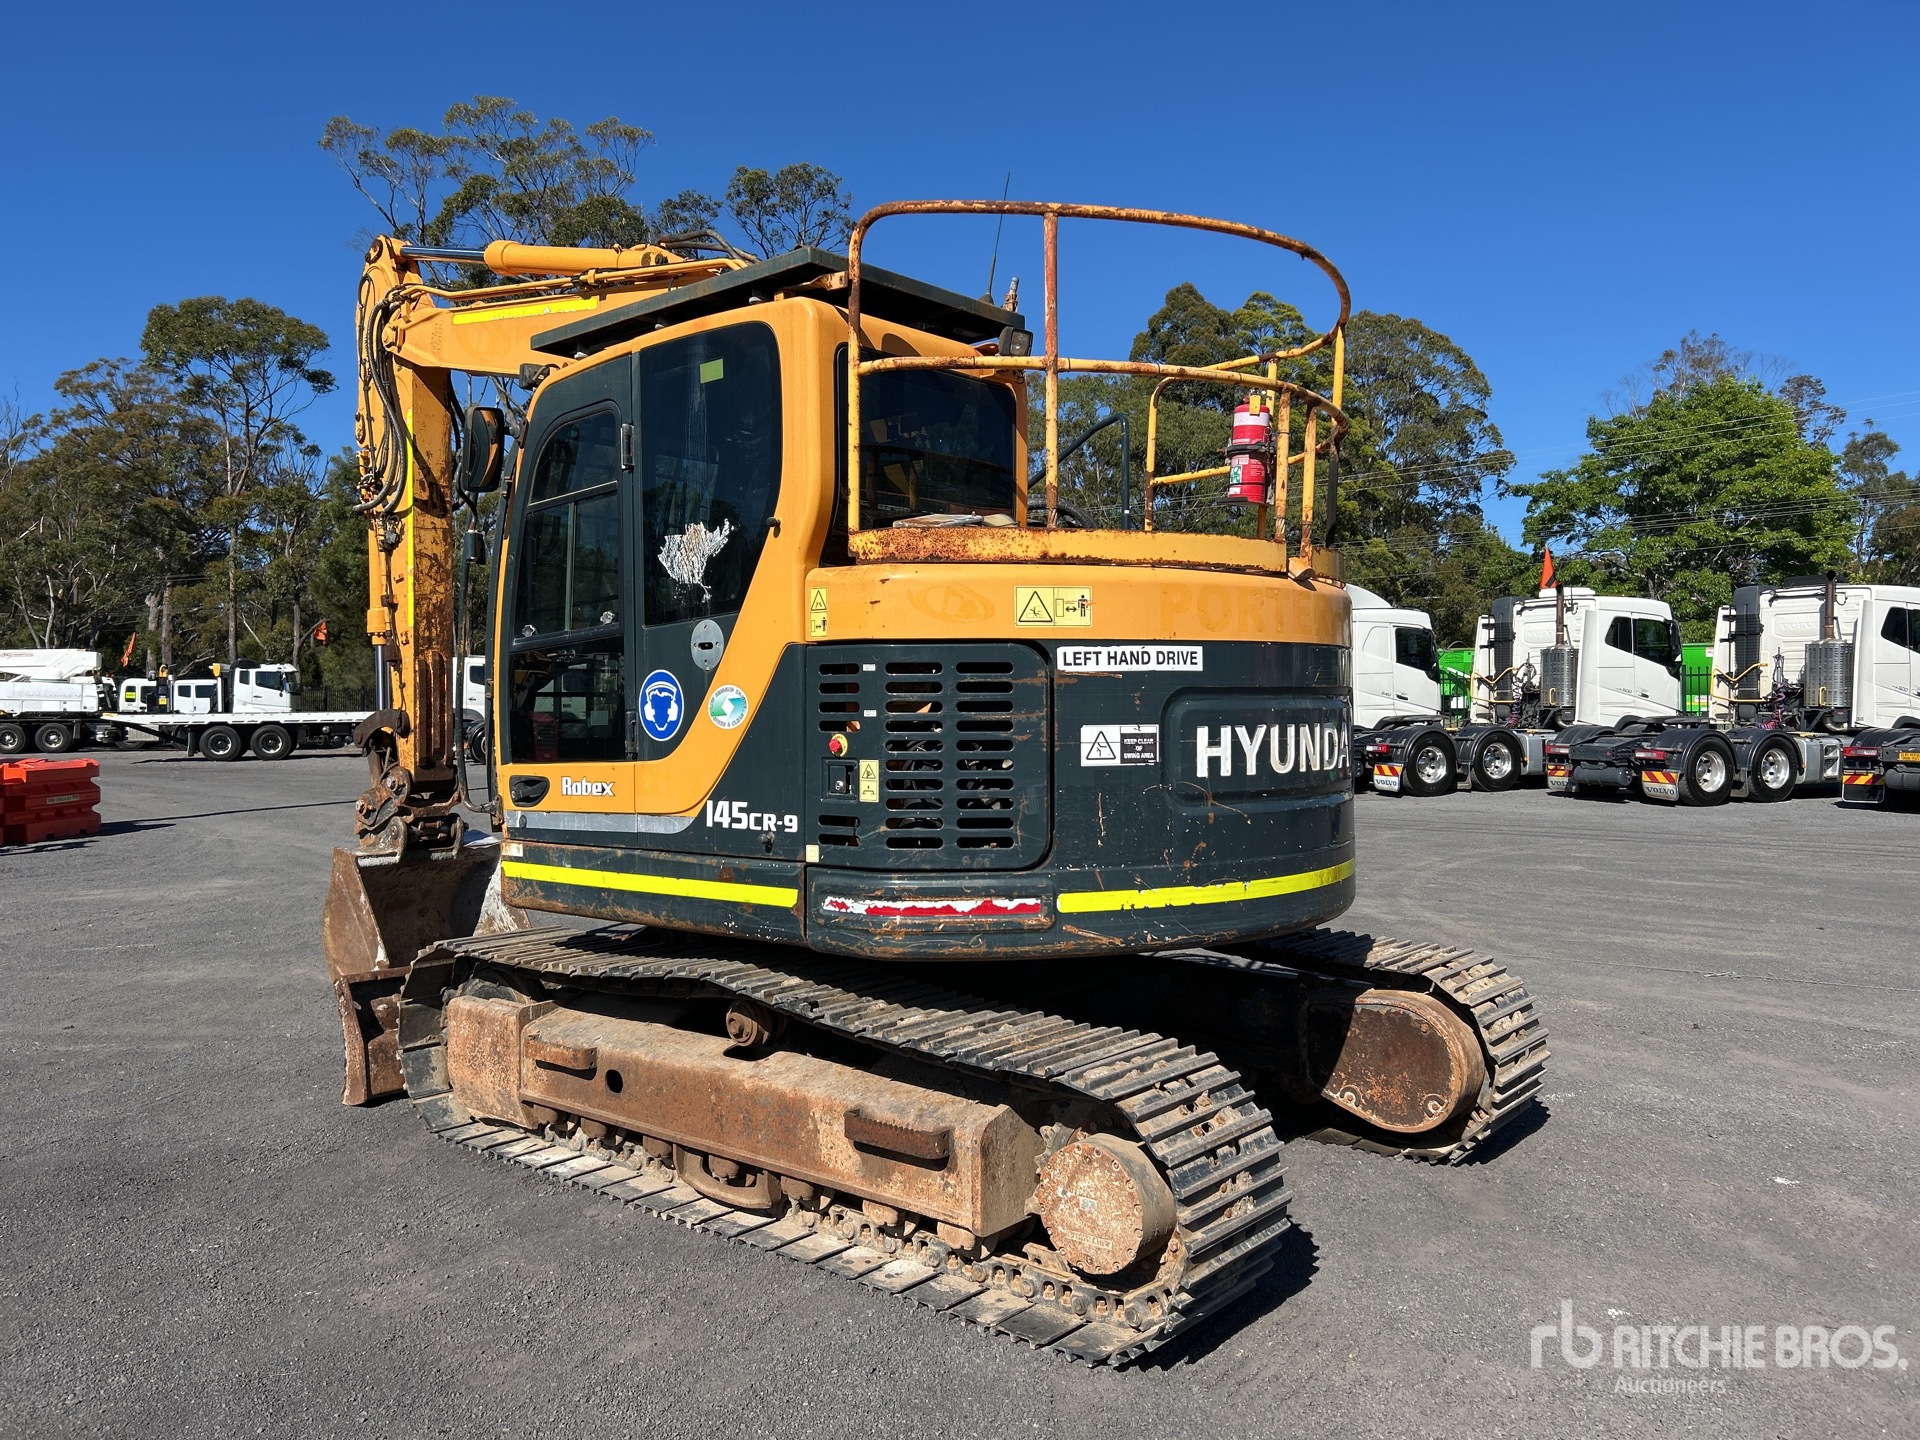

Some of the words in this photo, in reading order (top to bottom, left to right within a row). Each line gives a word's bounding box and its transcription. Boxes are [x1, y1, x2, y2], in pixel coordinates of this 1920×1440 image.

[1063, 651, 1102, 666] LEFT
[1107, 650, 1151, 665] HAND
[1156, 650, 1199, 665] DRIVE
[561, 775, 616, 796] Robex
[1375, 778, 1397, 787] VOLVO
[1645, 786, 1675, 796] VOLVO
[706, 799, 798, 833] 145CR-9
